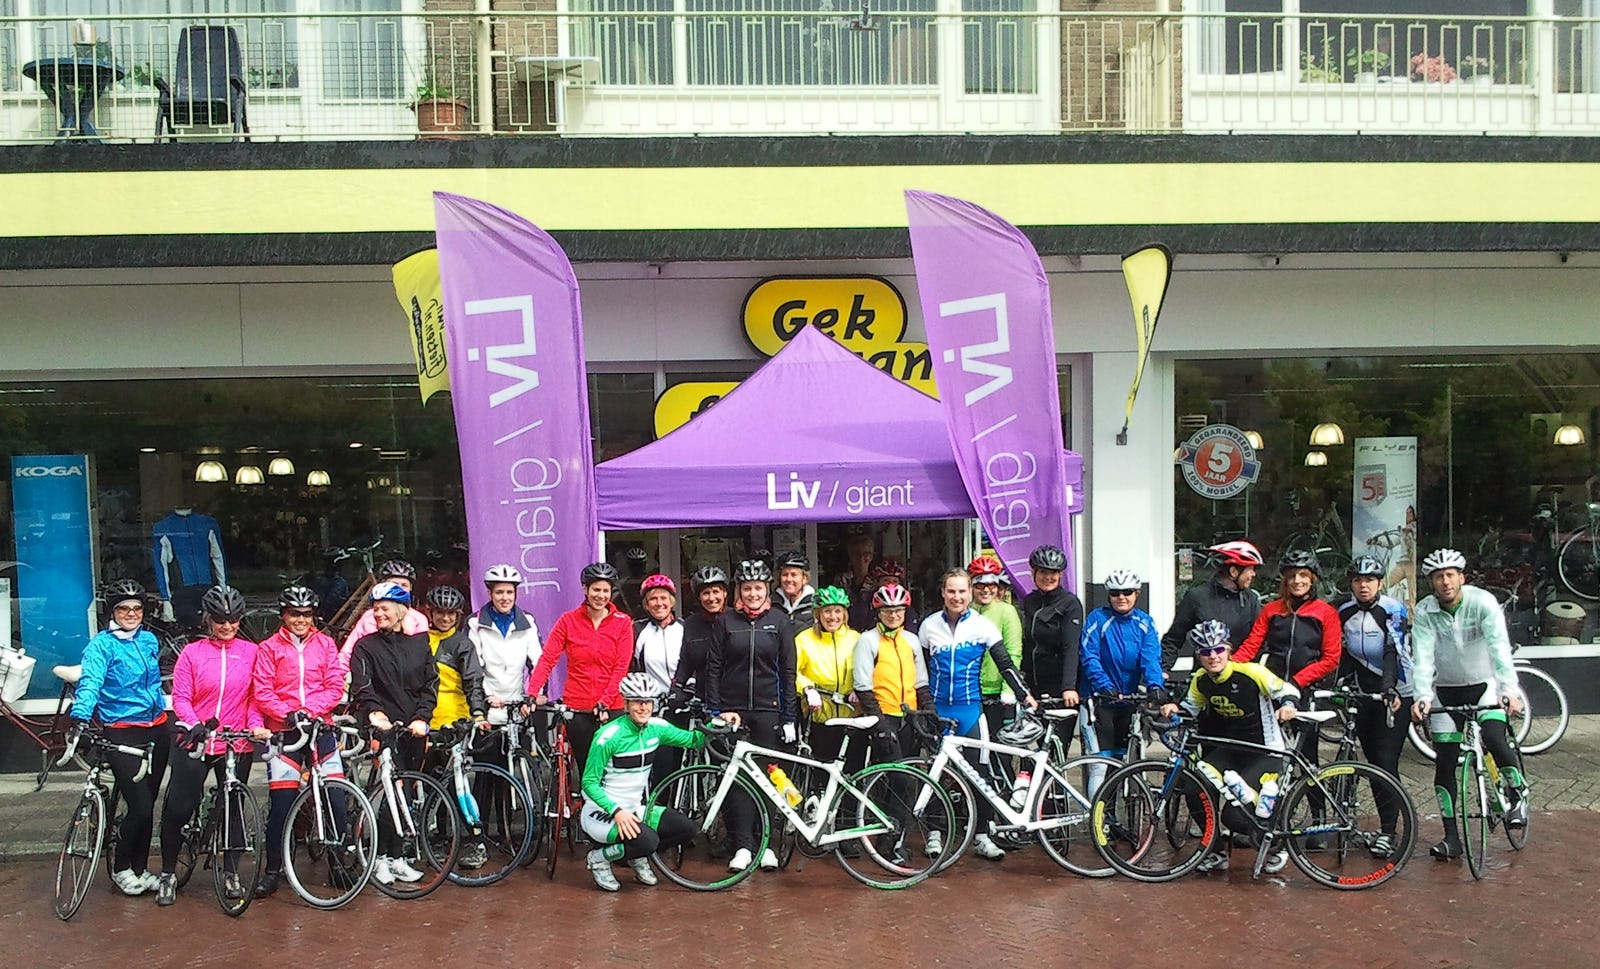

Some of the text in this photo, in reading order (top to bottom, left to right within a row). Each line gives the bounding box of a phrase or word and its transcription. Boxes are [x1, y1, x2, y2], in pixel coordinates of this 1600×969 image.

[773, 294, 875, 341] Gek
[854, 349, 933, 380] an
[1208, 443, 1234, 473] 5
[15, 466, 83, 478] KOGA
[1203, 471, 1226, 482] JAAR
[766, 472, 821, 510] Liv
[845, 479, 914, 513] giant
[1206, 484, 1239, 495] MOBIEL
[1361, 476, 1377, 501] 5
